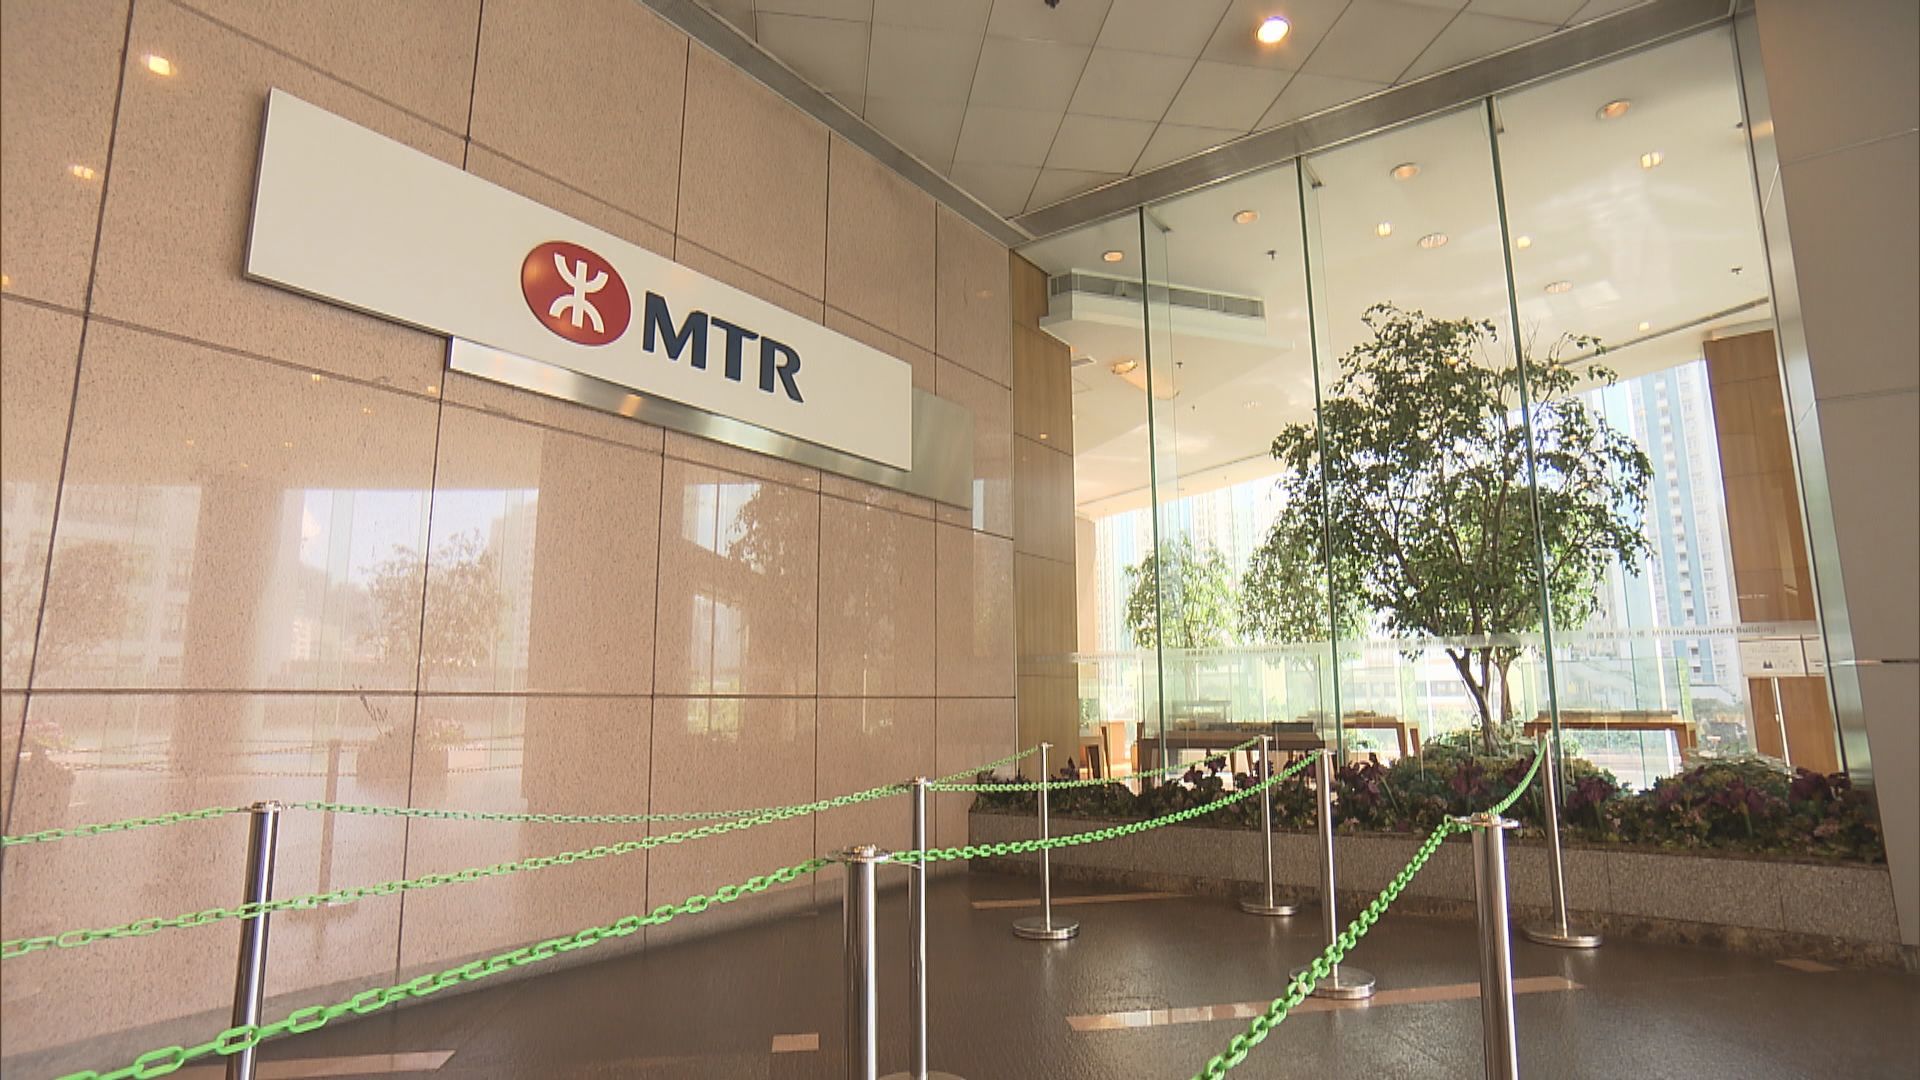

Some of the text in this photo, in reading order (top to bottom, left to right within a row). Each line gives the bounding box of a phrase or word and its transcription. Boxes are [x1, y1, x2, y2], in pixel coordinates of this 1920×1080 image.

[642, 290, 804, 403] MTR
[1672, 627, 1734, 637] Headquarters
[1736, 625, 1776, 635] Building
